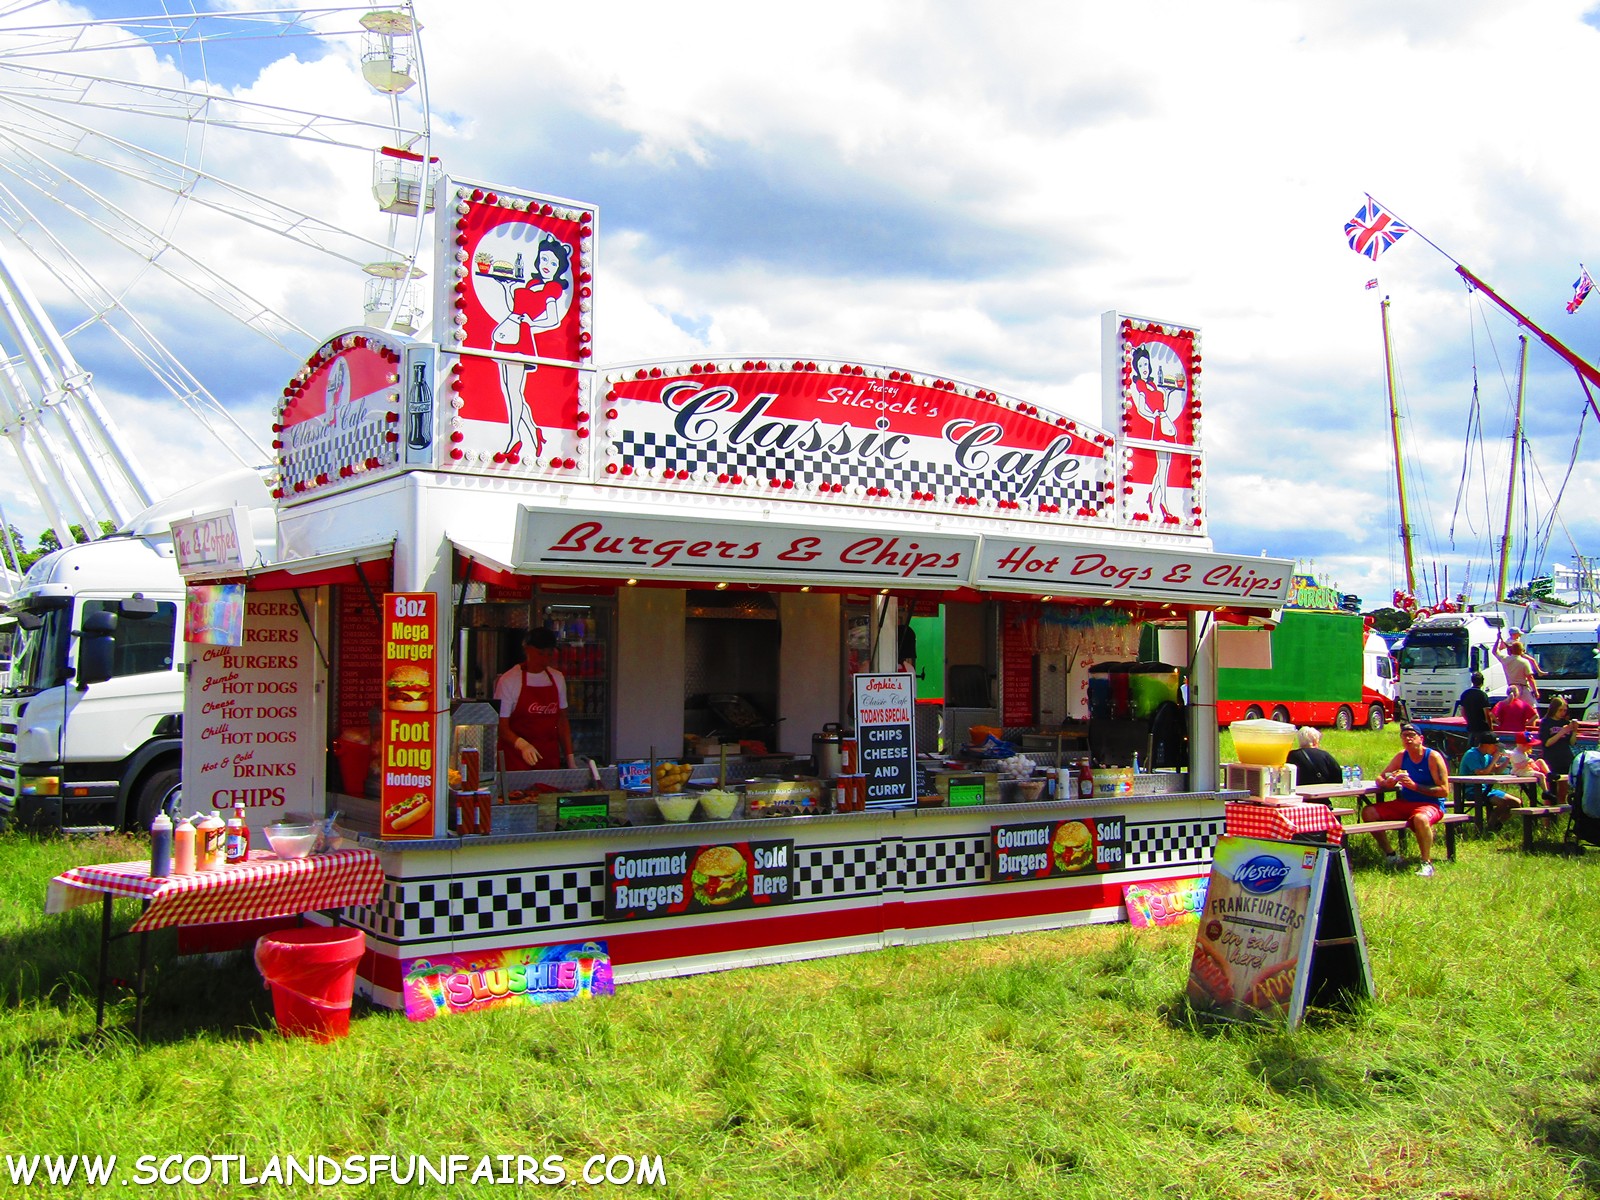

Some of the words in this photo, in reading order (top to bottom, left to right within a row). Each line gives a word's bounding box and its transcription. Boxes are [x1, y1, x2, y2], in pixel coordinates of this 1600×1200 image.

[867, 381, 899, 398] Tracey
[825, 387, 938, 418] Silcock's
[291, 418, 331, 448] Classic
[339, 398, 367, 438] Cafe
[661, 382, 911, 461] Classic
[945, 420, 1081, 499] Cafe
[547, 521, 760, 568] Burgers
[777, 537, 823, 562] &
[840, 536, 960, 578] Chips
[996, 545, 1059, 573] Hot
[1070, 553, 1153, 589] Dogs
[1161, 564, 1192, 583] &
[1202, 564, 1282, 597] Chips
[246, 602, 299, 616] RGERS
[395, 596, 426, 617] 8oz
[245, 629, 299, 642] RGERS
[392, 622, 429, 642] Mega
[202, 647, 230, 662] Chilli
[387, 641, 434, 661] Burger
[223, 655, 298, 669] BURGERS
[202, 672, 239, 691] Jumbo
[222, 682, 254, 694] HOT
[257, 681, 297, 693] DOGS
[866, 678, 902, 692] Sophie's
[201, 699, 236, 714] Cheese
[861, 694, 887, 706] Classic
[889, 693, 908, 706] Cafe
[222, 707, 253, 719] HOT
[256, 706, 297, 719] DOGS
[860, 709, 884, 724] TODAYS
[885, 708, 910, 723] SPECIAL
[201, 723, 229, 740] Chilli
[221, 732, 253, 744] HOT
[256, 731, 297, 743] DOGS
[391, 719, 430, 742] Foot
[869, 729, 903, 741] CHIPS
[201, 762, 219, 773] Hot
[220, 757, 229, 768] &
[232, 750, 254, 764] Cold
[388, 745, 431, 771] Long
[864, 747, 908, 760] CHEESE
[233, 763, 296, 778] DRINKS
[386, 772, 431, 788] Hotdogs
[874, 766, 899, 778] AND
[868, 783, 906, 797] CURRY
[1099, 784, 1115, 792] VISA
[212, 787, 286, 809] CHIPS
[997, 825, 1050, 849] Gourmet
[1097, 822, 1121, 841] Sold
[614, 851, 687, 880] Gourmet
[754, 846, 787, 869] Sold
[998, 853, 1048, 875] Burgers
[1096, 845, 1122, 864] Here
[1234, 863, 1291, 882] Westlers
[615, 883, 684, 911] Burgers
[752, 875, 788, 896] Here
[1150, 888, 1207, 919] SLUSH
[1211, 896, 1305, 930] FRANKFURTERS
[1221, 929, 1244, 947] on
[1248, 932, 1280, 953] sale
[1229, 949, 1267, 969] here!
[449, 962, 577, 1005] SLUSHIE
